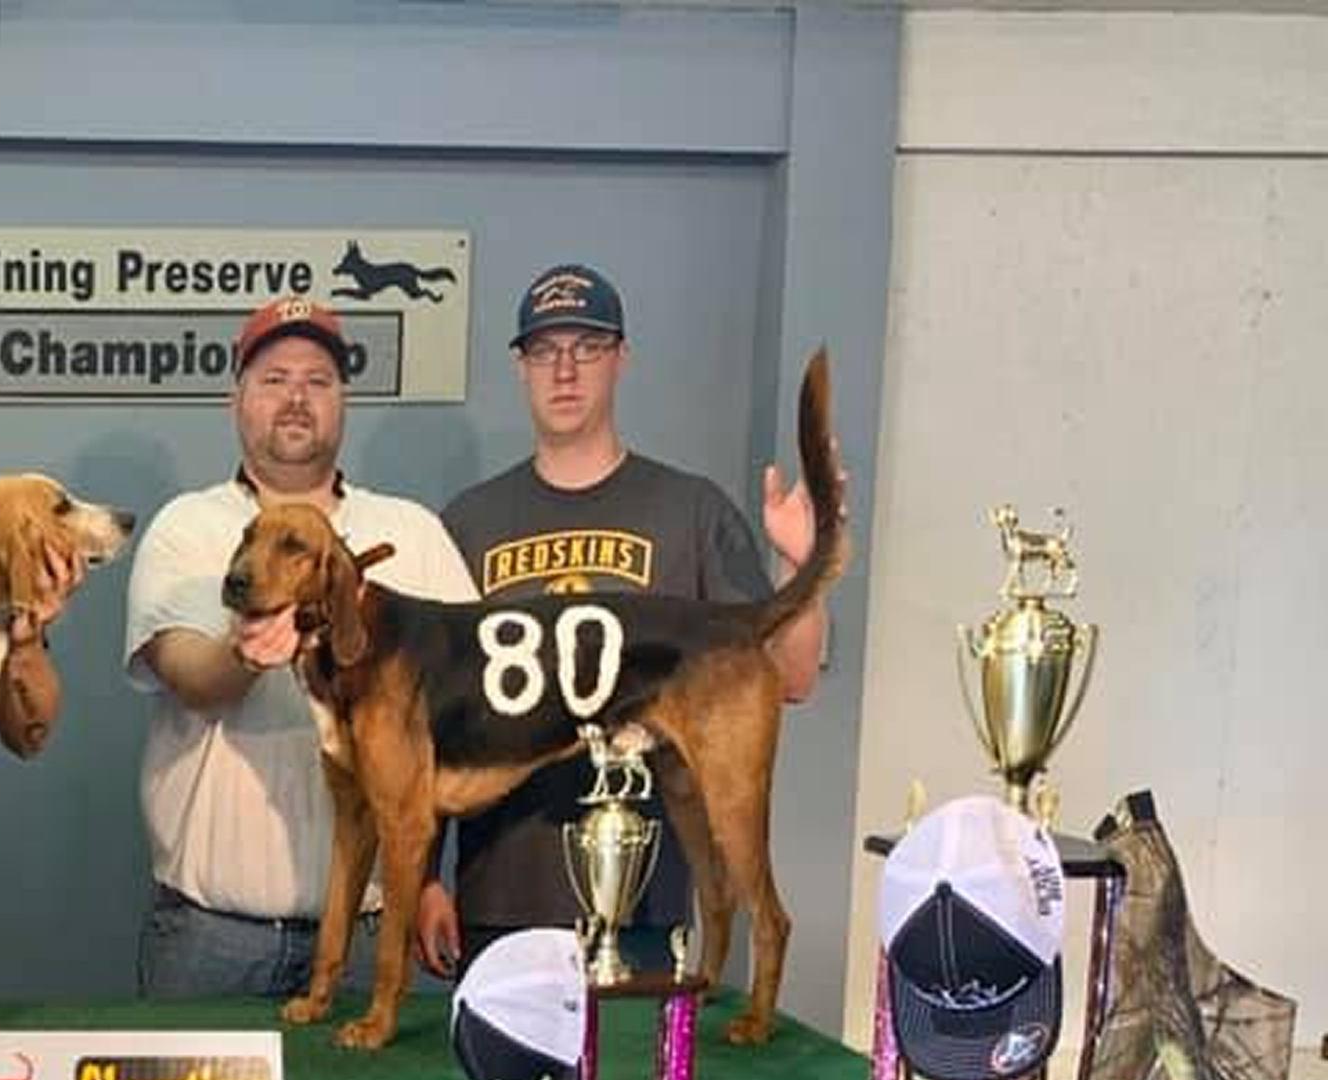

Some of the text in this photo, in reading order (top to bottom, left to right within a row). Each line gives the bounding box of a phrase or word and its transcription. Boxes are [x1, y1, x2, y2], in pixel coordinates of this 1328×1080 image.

[118, 251, 312, 294] Preserve
[496, 537, 634, 579] REDSKINS
[478, 605, 623, 718] 80
